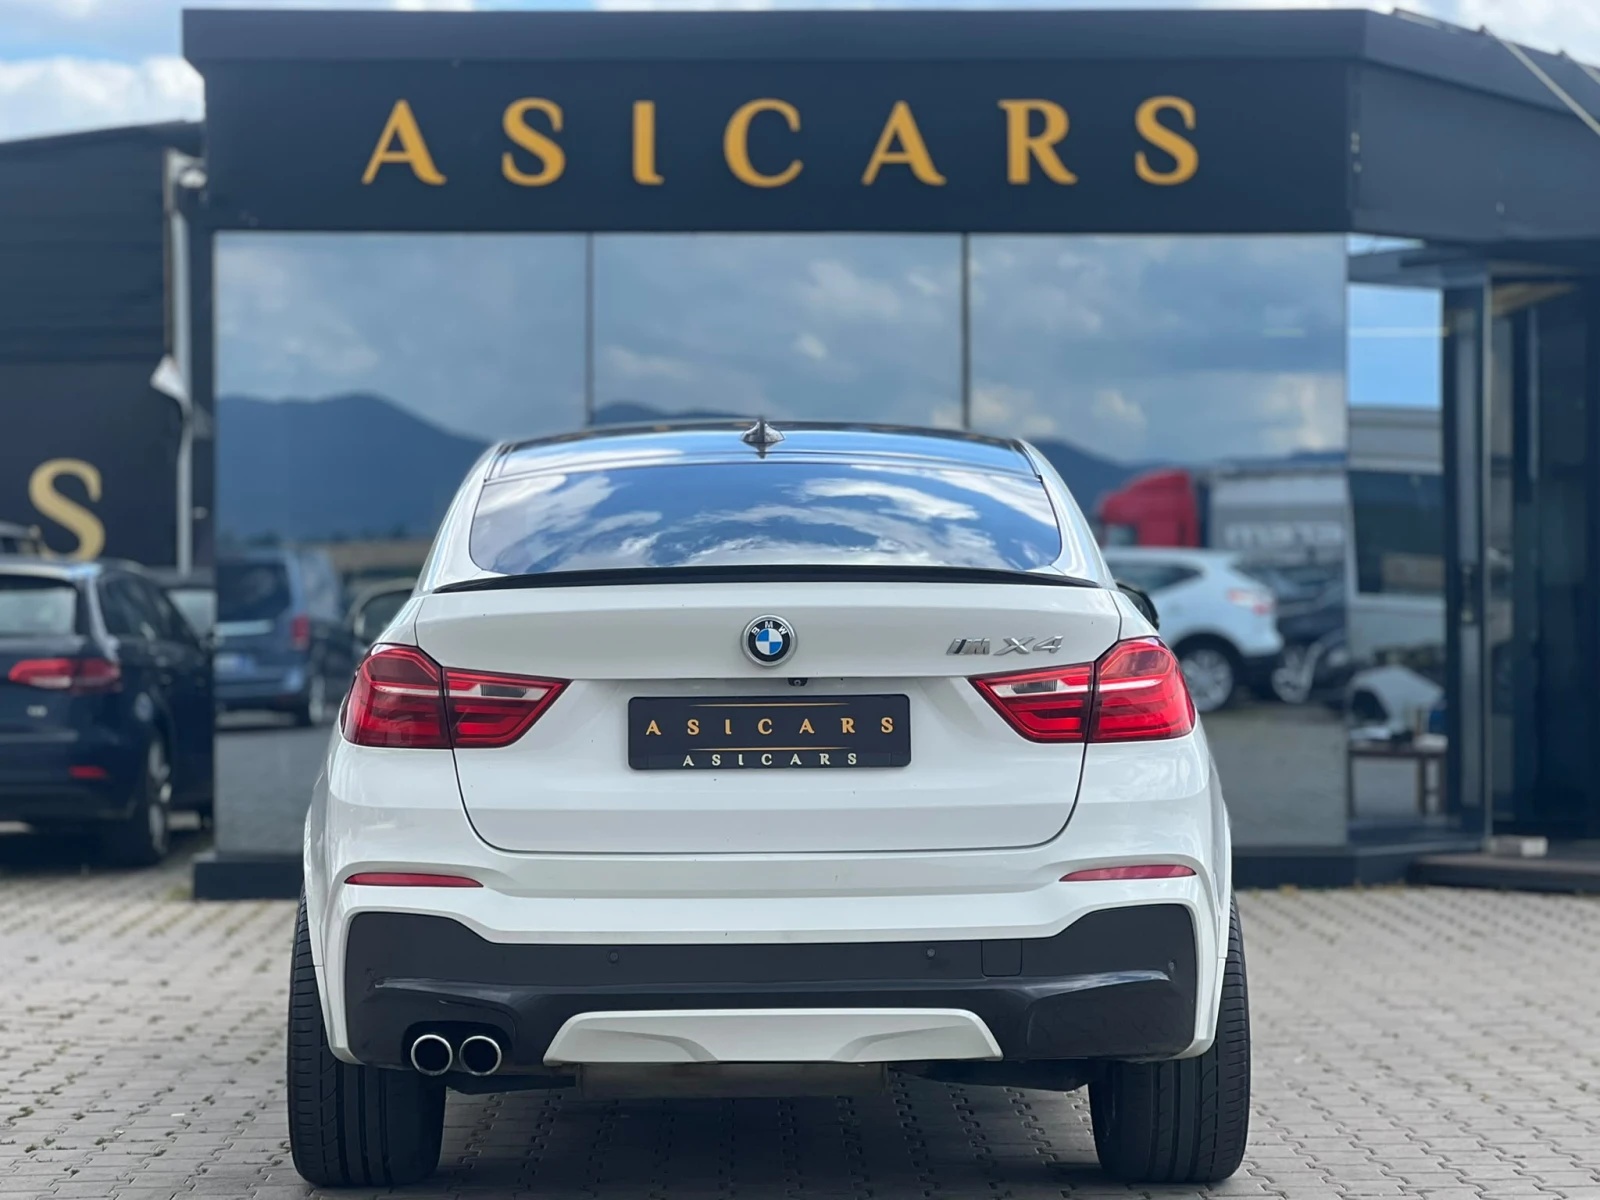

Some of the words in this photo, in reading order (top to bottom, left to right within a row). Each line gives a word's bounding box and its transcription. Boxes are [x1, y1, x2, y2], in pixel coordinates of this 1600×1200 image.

[361, 96, 1200, 187] ASICARS
[751, 620, 788, 635] BMW
[645, 716, 894, 736] ASICARS
[682, 752, 857, 767] ASICARS
